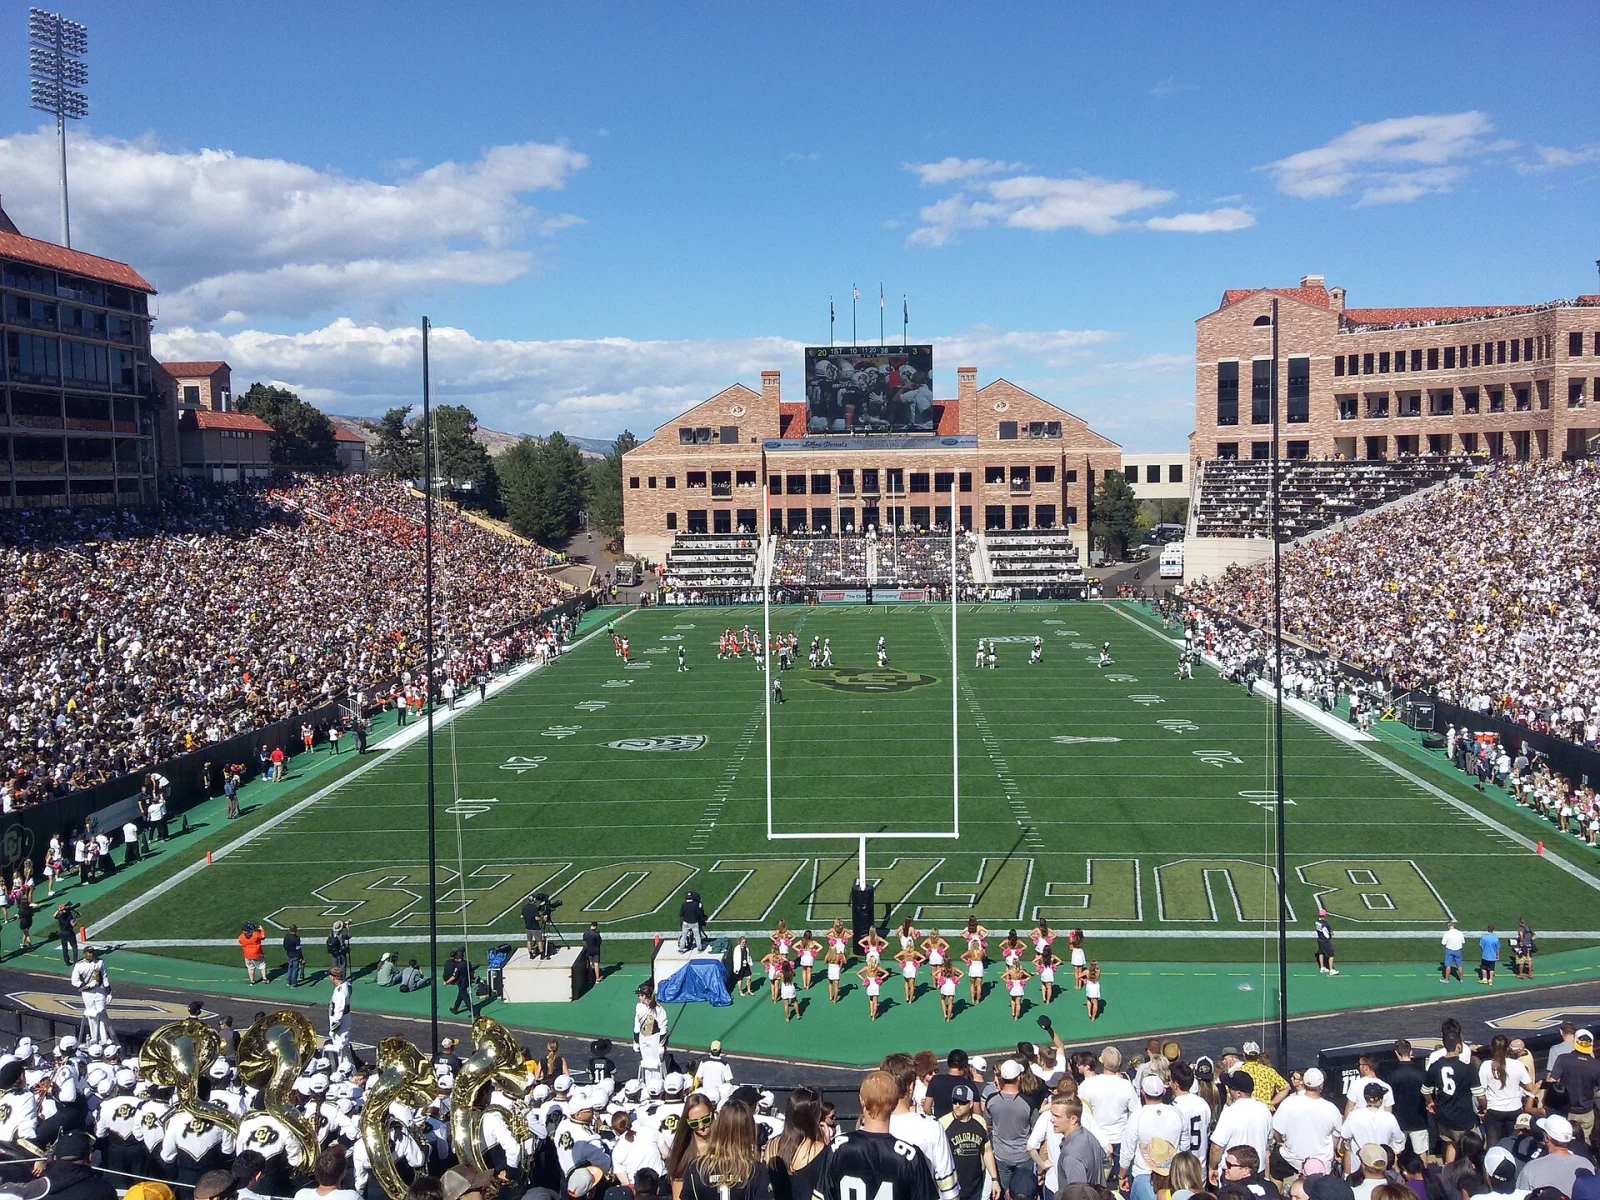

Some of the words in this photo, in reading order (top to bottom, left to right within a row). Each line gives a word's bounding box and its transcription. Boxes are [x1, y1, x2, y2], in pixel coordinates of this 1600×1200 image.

[817, 349, 827, 357] 20
[1440, 1066, 1457, 1096] 6
[950, 1132, 983, 1146] COLORADO
[1189, 1114, 1202, 1151] 5
[893, 1139, 916, 1161] 9
